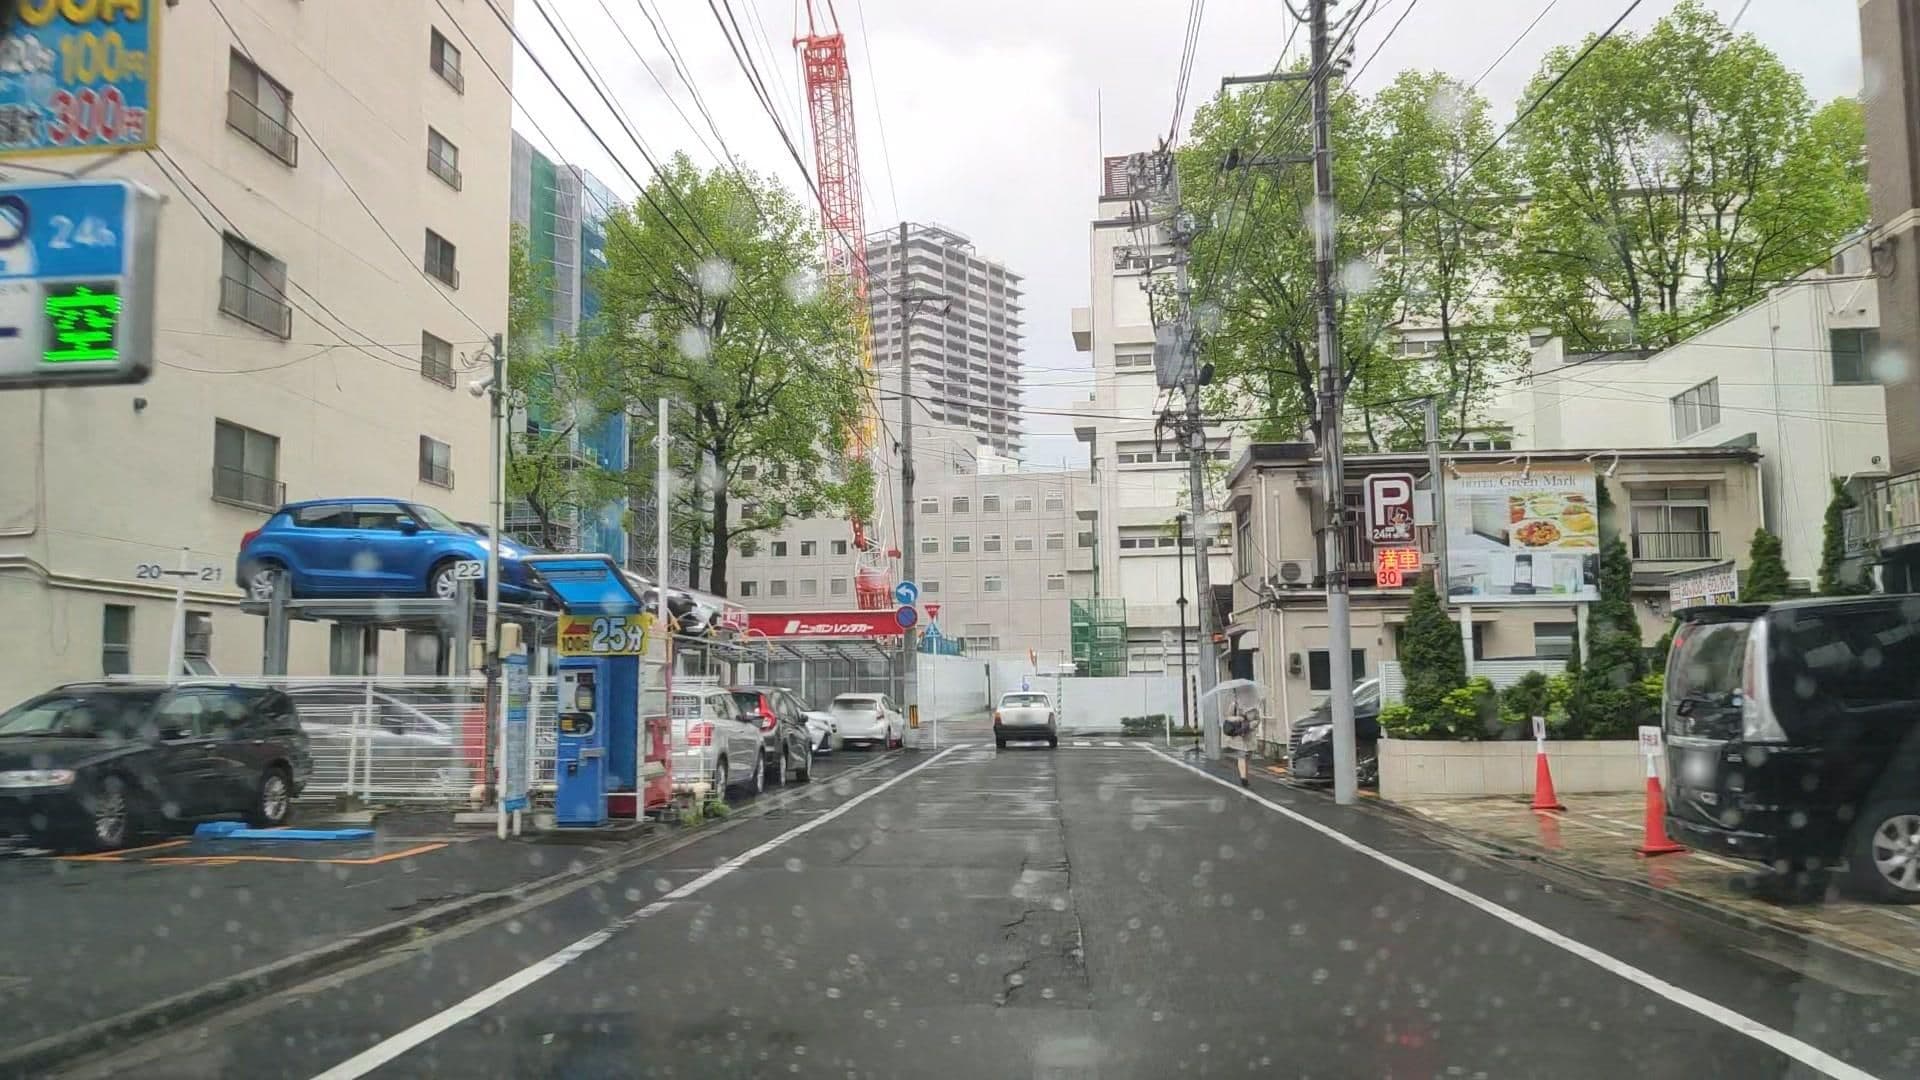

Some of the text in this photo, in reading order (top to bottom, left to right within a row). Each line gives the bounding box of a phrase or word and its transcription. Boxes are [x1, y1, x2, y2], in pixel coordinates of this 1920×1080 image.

[1500, 474, 1538, 487] Green
[1544, 474, 1576, 487] Mark
[1374, 481, 1410, 526] P
[1379, 549, 1420, 569] 満車
[136, 564, 161, 579] 20
[201, 567, 221, 581] 21
[458, 562, 481, 577] 22
[1379, 571, 1397, 584] 30
[592, 616, 644, 652] 25分
